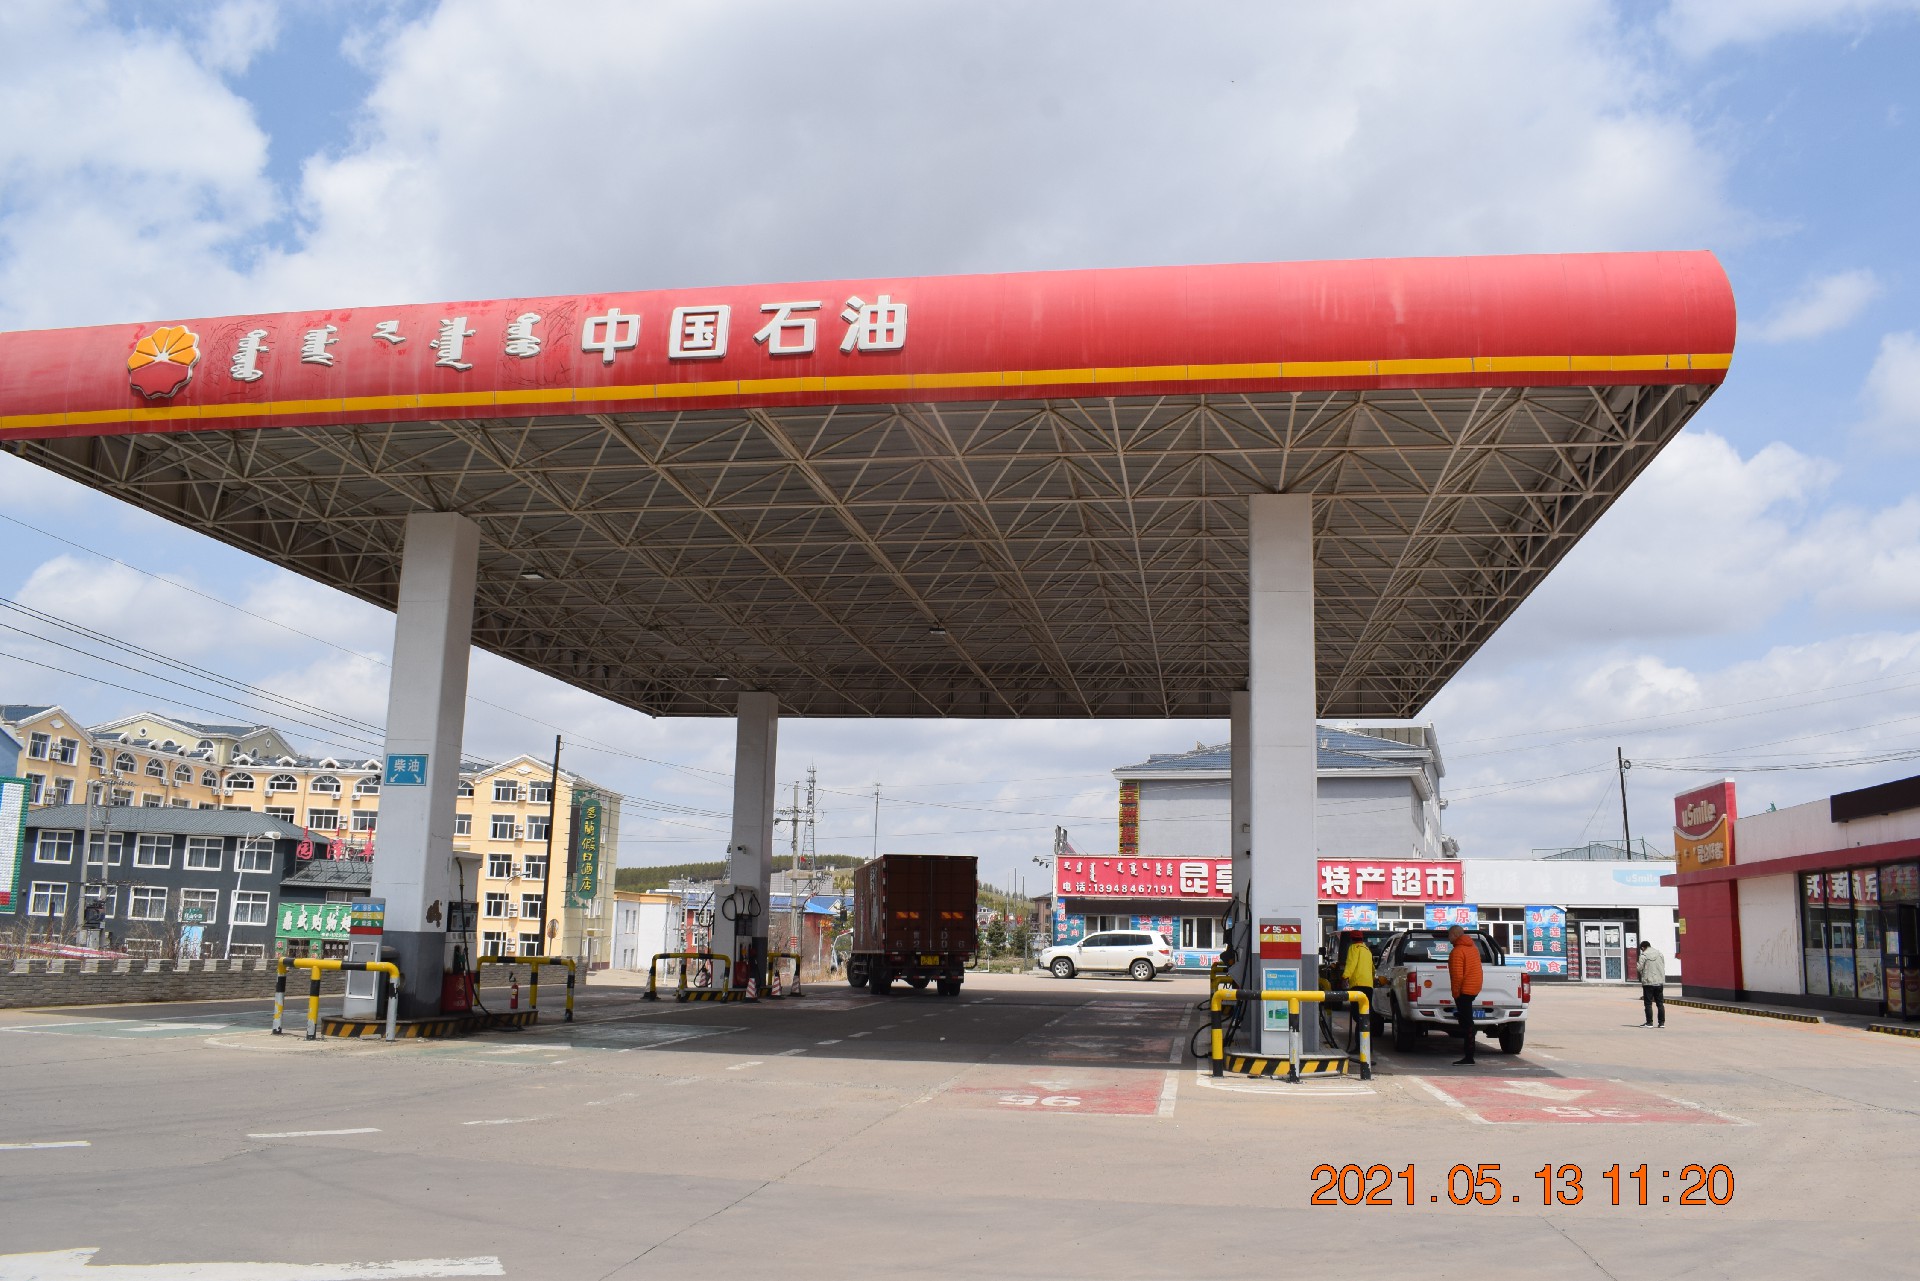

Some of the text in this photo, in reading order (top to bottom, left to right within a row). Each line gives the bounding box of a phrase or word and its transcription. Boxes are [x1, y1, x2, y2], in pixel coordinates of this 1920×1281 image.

[581, 294, 908, 364] 中国石油
[394, 758, 420, 773] 柴油
[1681, 799, 1716, 828] uSmile
[1321, 865, 1455, 897] 特产超市
[1343, 908, 1371, 923] 手工
[1433, 908, 1470, 923] 草原
[1272, 925, 1282, 934] 95
[1532, 913, 1543, 952] 奶食品
[1550, 913, 1561, 952] 金莲花
[1526, 960, 1561, 973] 奶食
